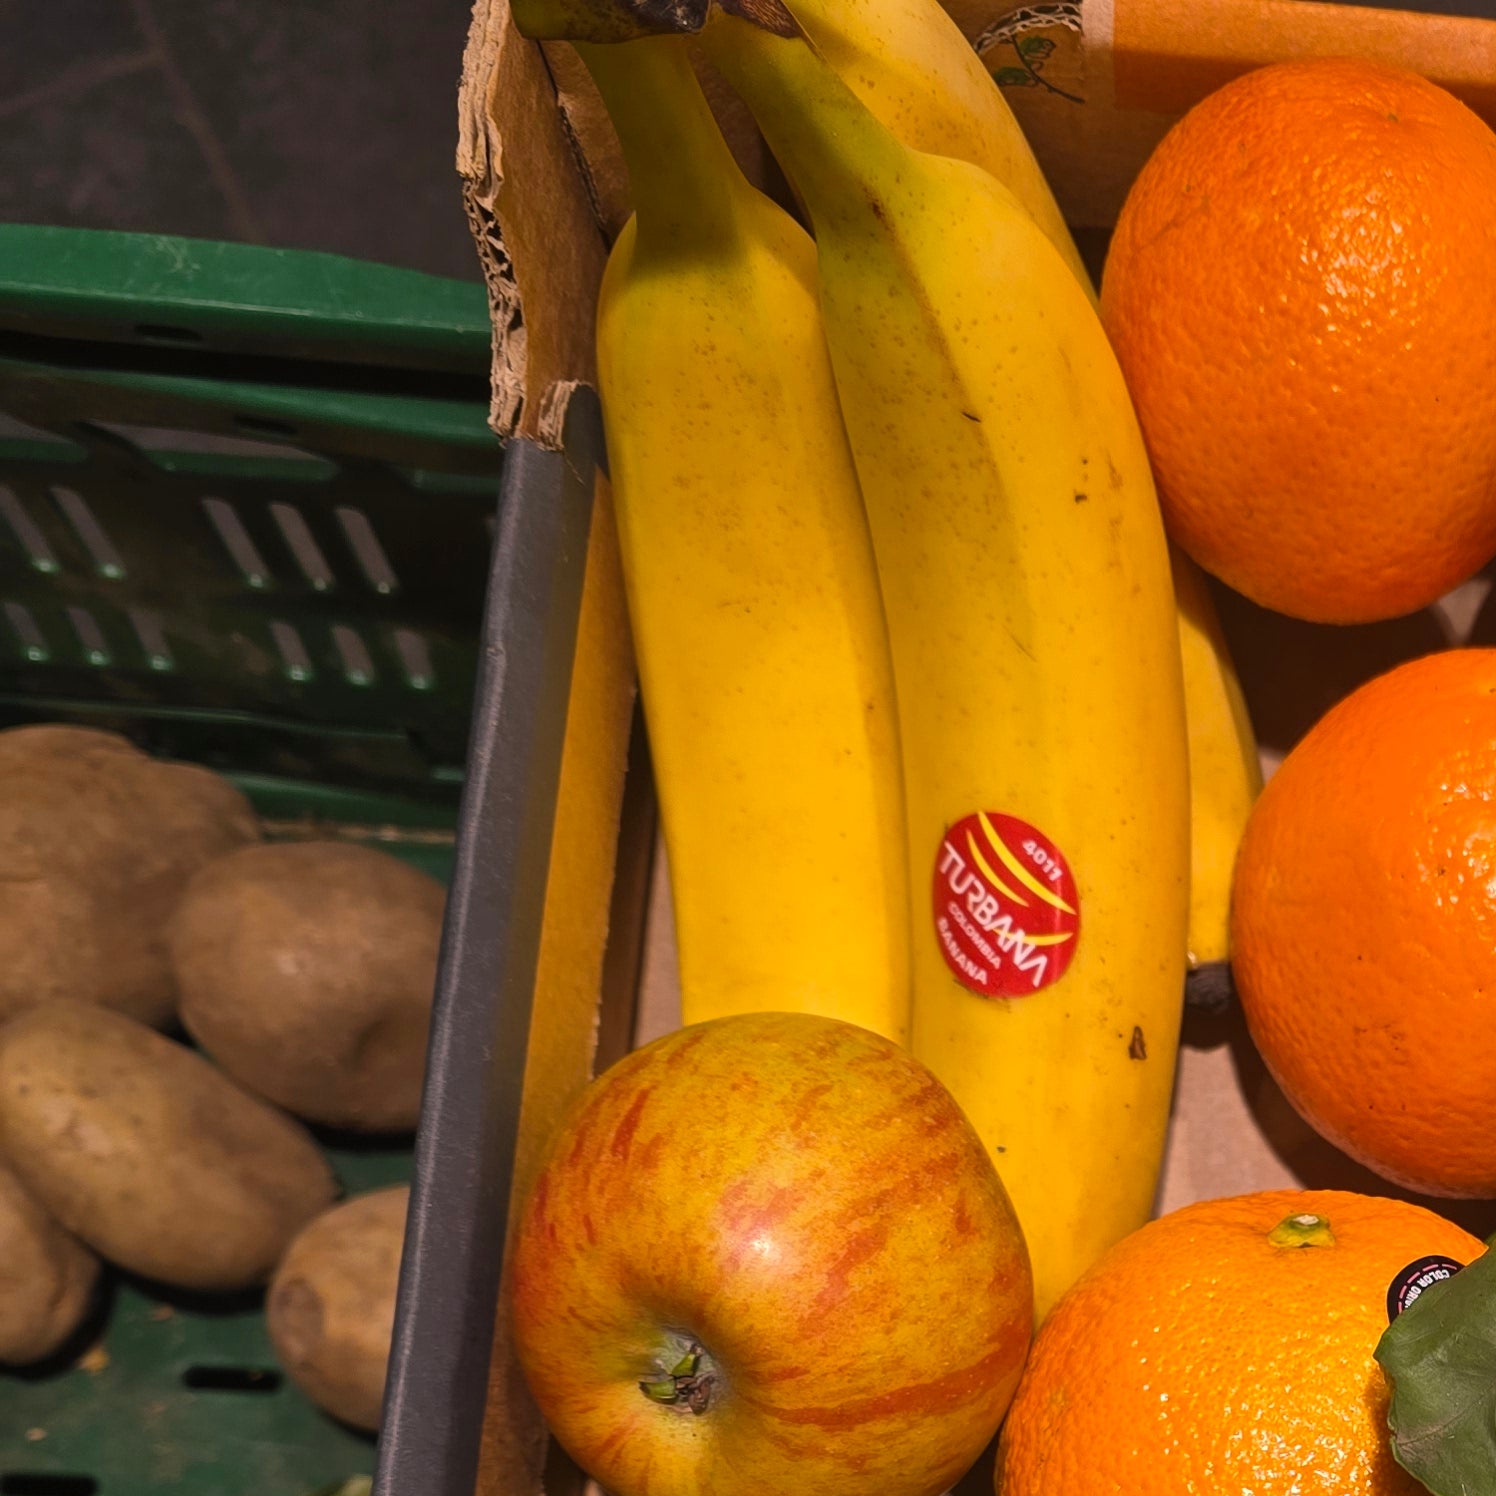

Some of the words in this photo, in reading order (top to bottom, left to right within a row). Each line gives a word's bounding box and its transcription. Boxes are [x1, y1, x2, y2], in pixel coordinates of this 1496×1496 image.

[1022, 839, 1063, 882] 4011
[938, 840, 1048, 988] TURBANA
[948, 900, 1001, 970] COLOMBIA
[937, 916, 988, 986] BANANA
[1416, 1269, 1451, 1288] COLOR
